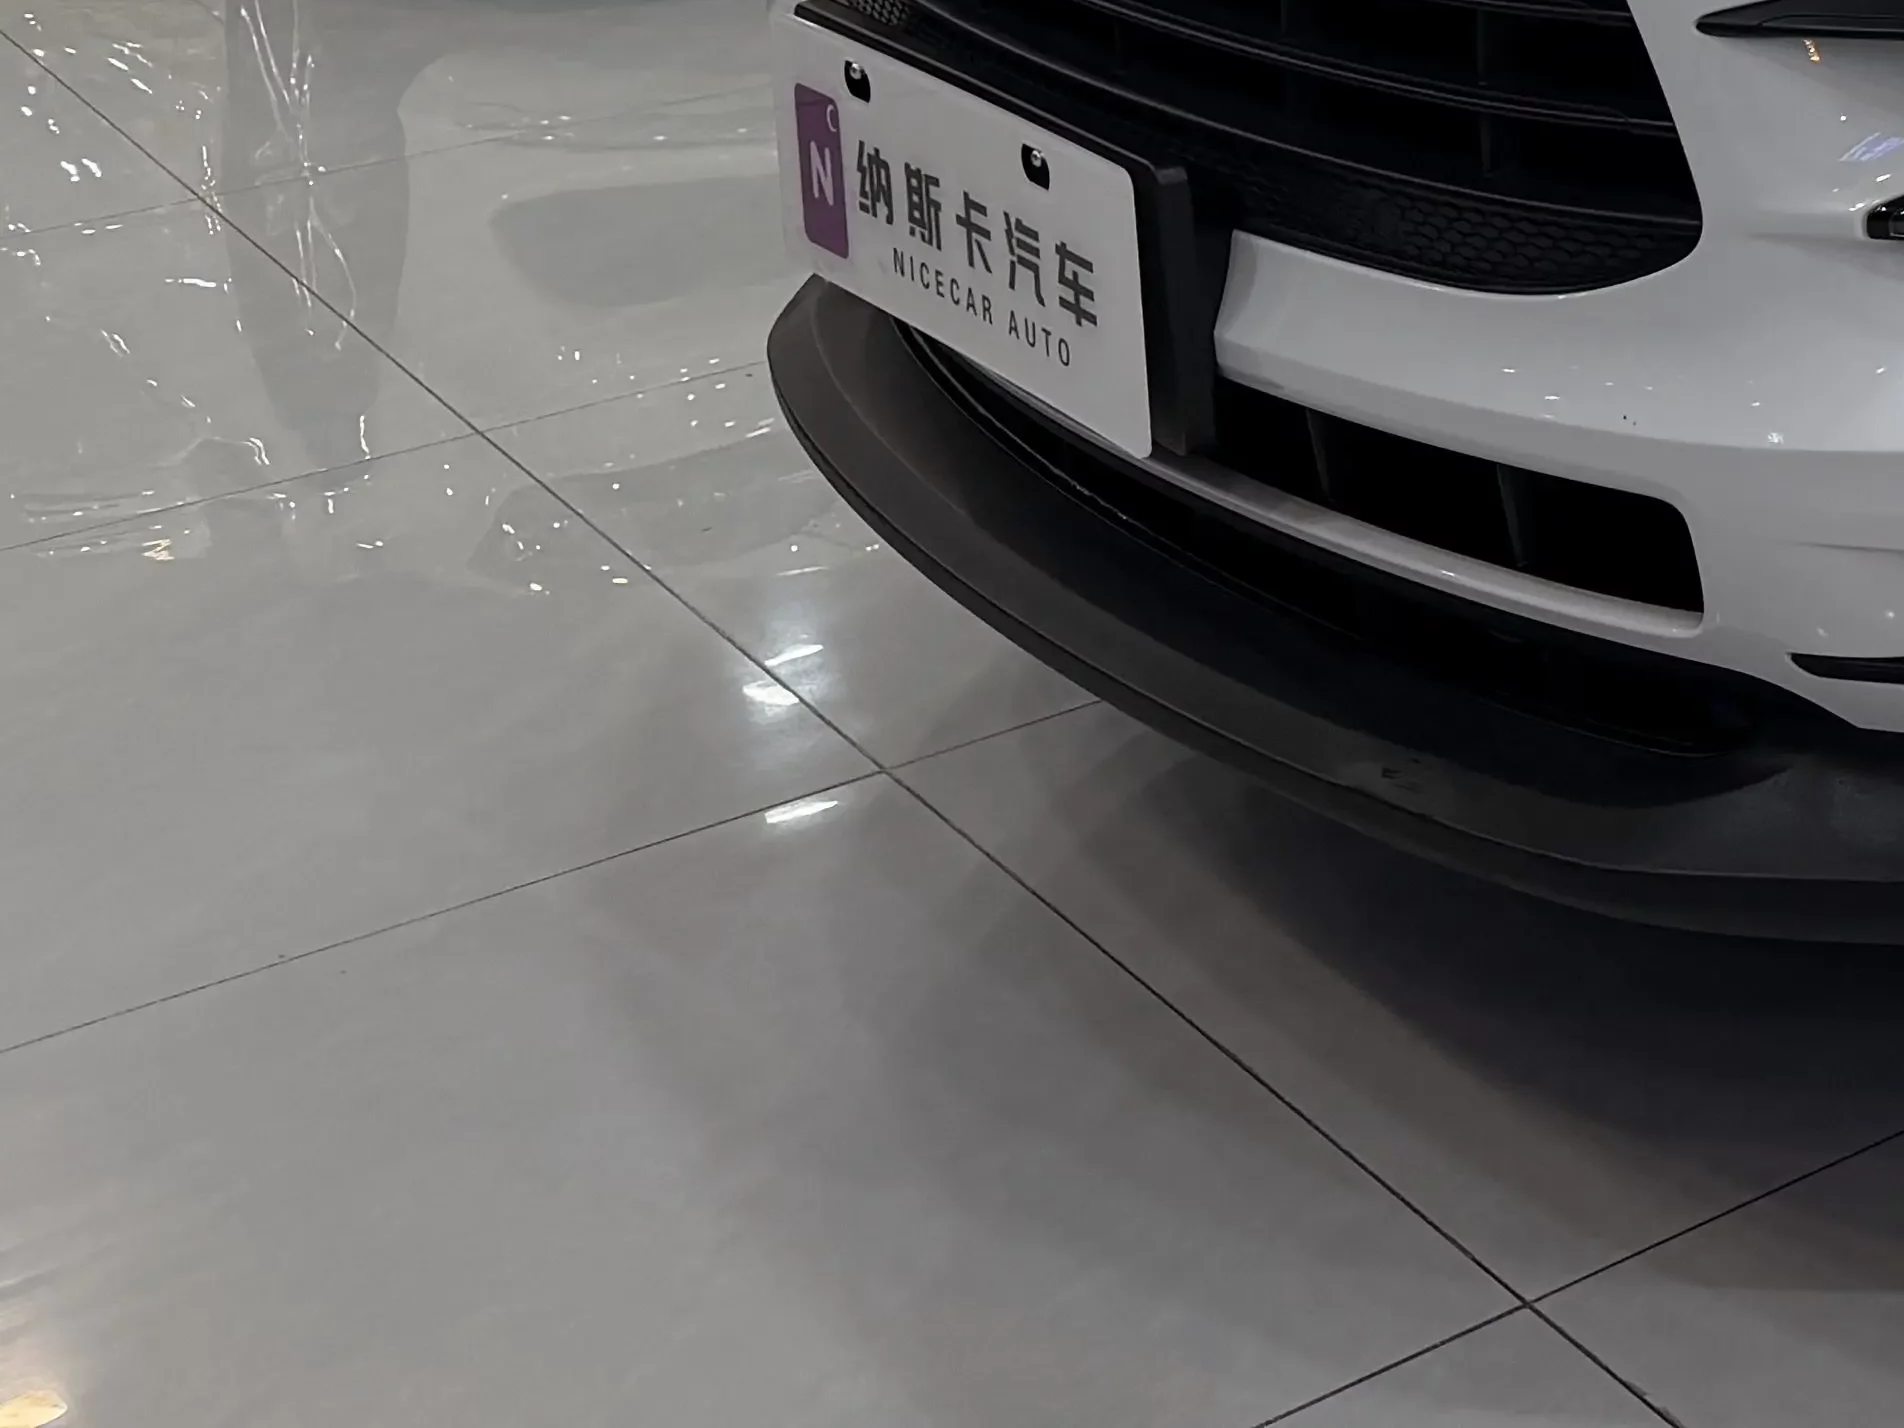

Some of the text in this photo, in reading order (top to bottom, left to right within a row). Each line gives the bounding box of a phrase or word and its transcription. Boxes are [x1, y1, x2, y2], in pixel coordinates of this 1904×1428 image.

[809, 140, 834, 206] N
[856, 140, 1098, 328] 纳斯卡汽车
[892, 246, 1072, 367] NICECAR AUTO
